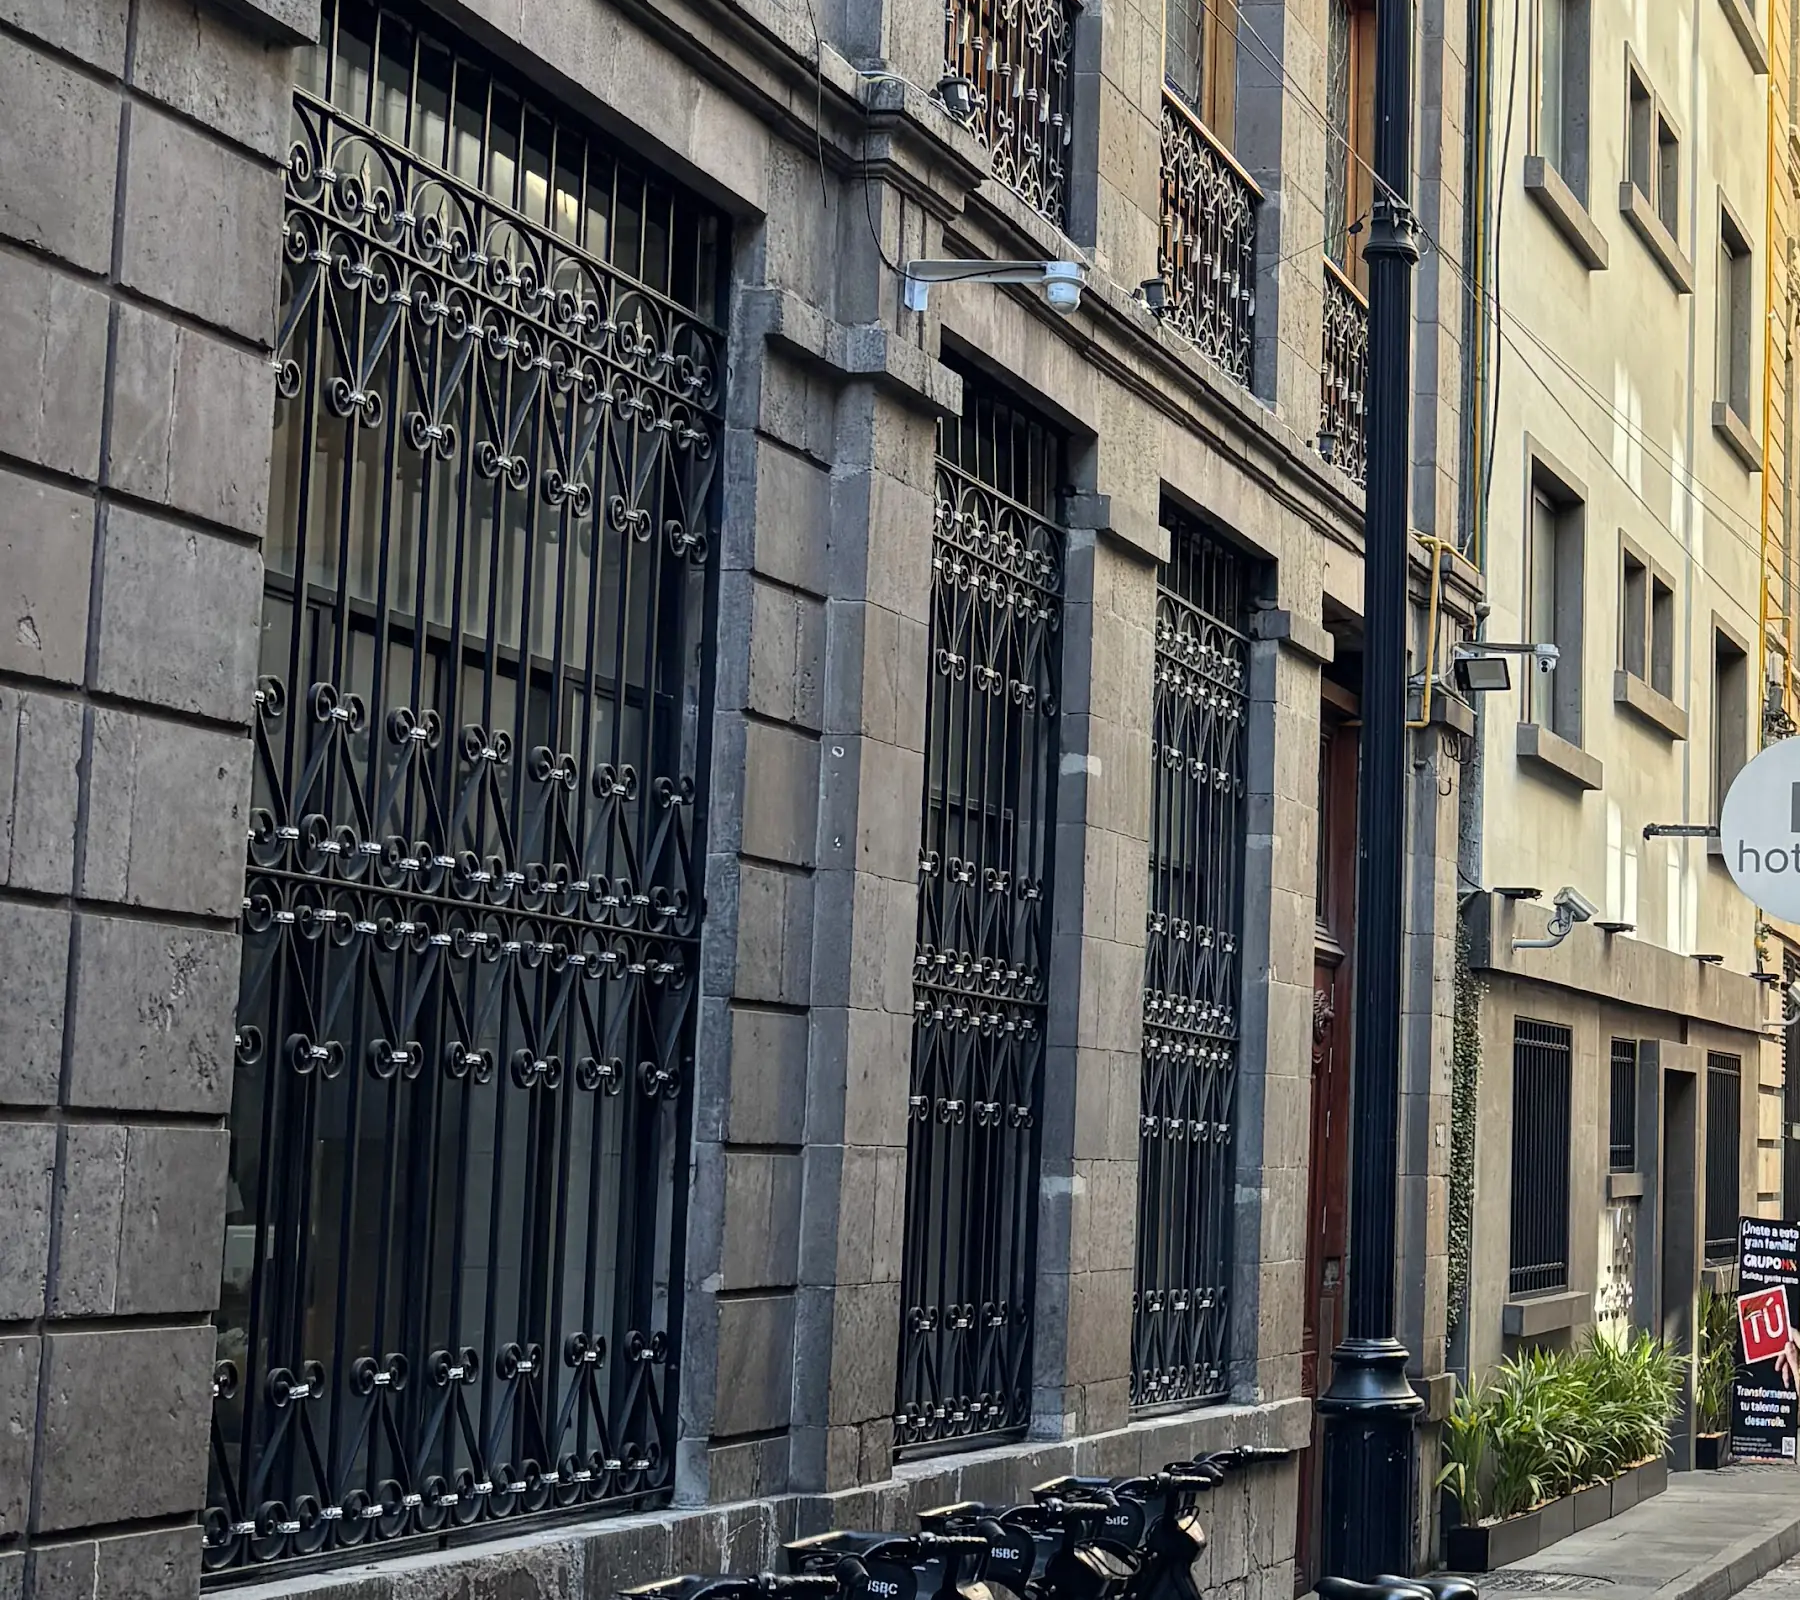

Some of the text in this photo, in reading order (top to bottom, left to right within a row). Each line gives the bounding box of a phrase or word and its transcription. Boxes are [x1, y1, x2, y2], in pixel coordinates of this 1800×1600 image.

[1744, 1296, 1785, 1344] TÚ
[1736, 1385, 1797, 1401] Transformamos
[1740, 1401, 1791, 1414] tu talento en
[1105, 1515, 1129, 1527] SBC
